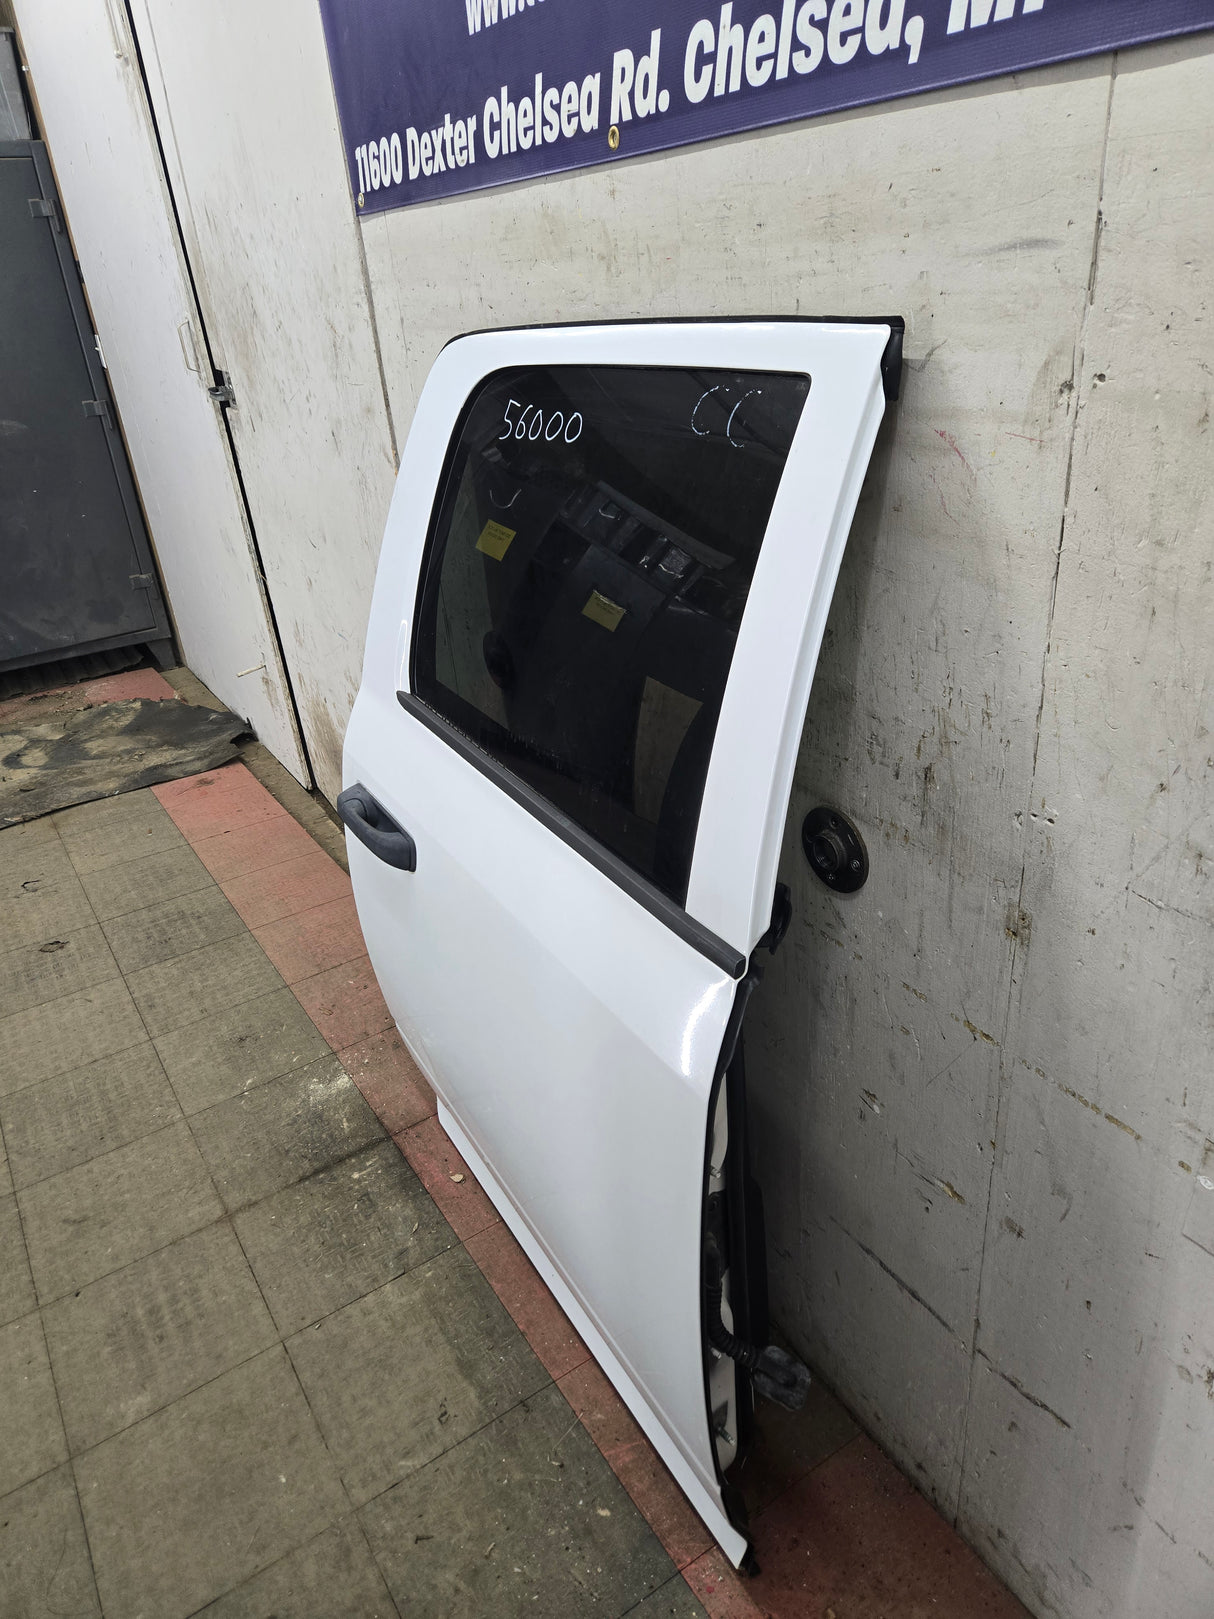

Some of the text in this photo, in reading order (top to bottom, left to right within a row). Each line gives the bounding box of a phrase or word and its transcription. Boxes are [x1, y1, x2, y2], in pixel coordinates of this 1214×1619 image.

[355, 132, 403, 194] 11600
[406, 113, 478, 181] Dexter
[482, 72, 602, 159] Chelsea
[609, 27, 671, 126] Rd.
[683, 0, 926, 104] Chelsea,
[499, 399, 584, 443] 56000
